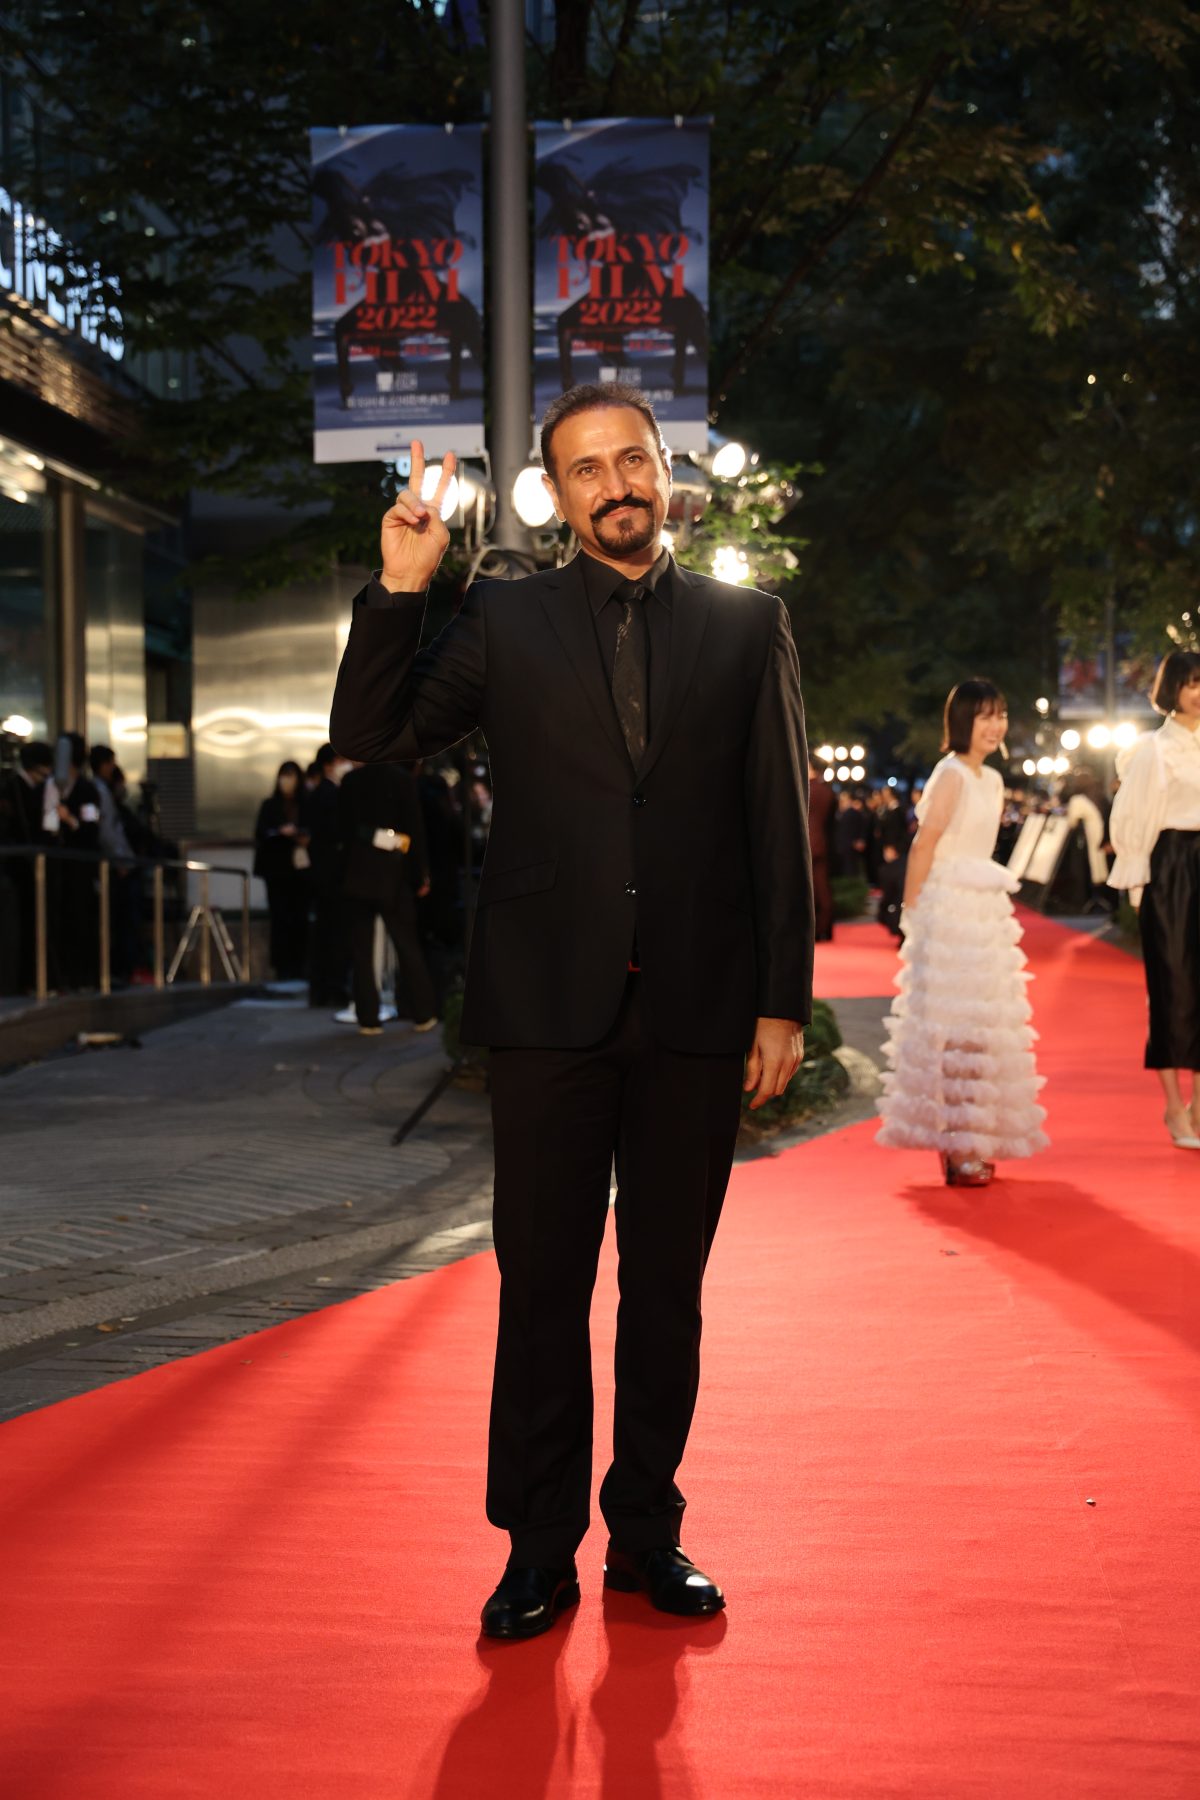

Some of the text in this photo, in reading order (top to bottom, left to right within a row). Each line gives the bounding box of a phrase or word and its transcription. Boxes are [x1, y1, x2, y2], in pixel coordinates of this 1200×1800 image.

[328, 238, 464, 269] TOKYO
[550, 232, 689, 263] TOKYO
[335, 268, 460, 305] FILM
[557, 263, 686, 298] FILM
[356, 304, 437, 330] 2022
[580, 299, 662, 325] 2022
